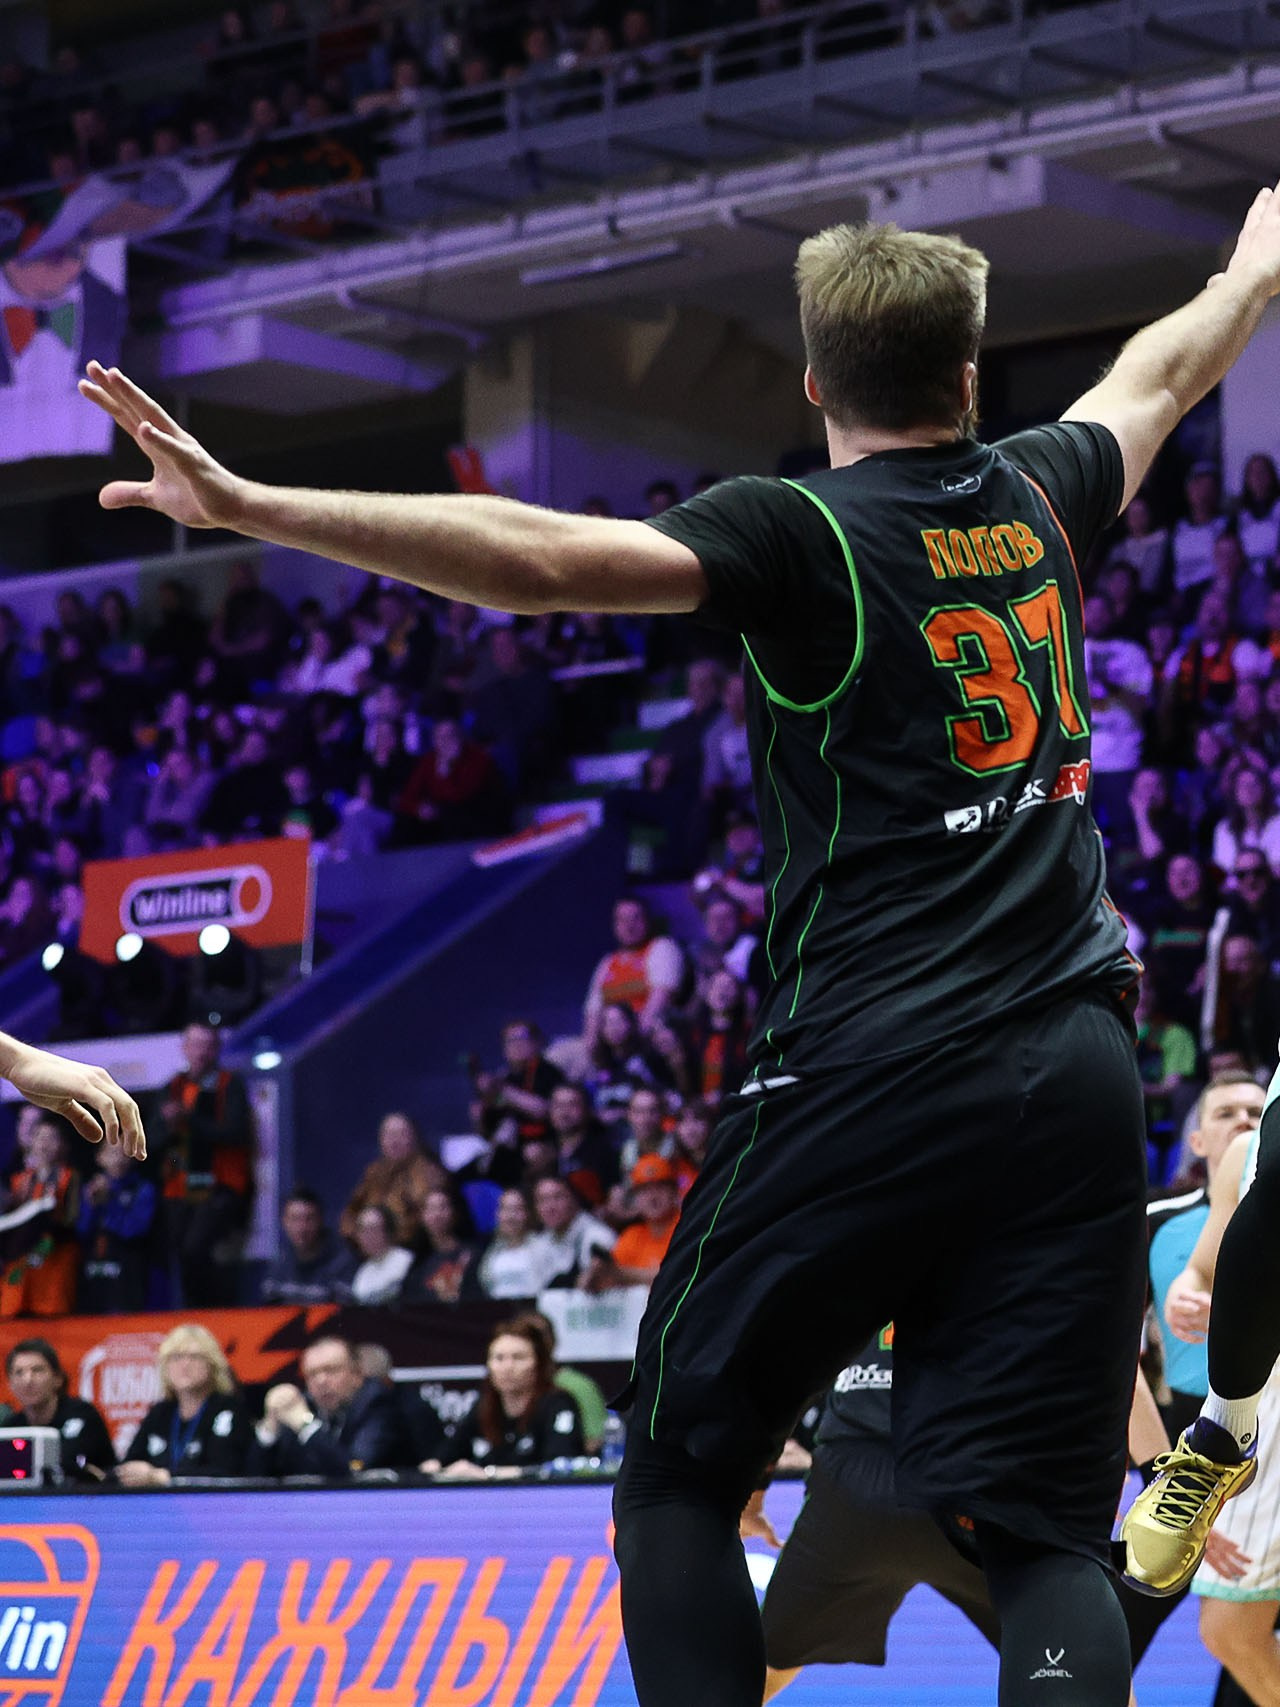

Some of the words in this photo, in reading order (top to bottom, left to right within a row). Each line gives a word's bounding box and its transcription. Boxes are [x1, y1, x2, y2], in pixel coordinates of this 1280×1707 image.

[921, 520, 1044, 579] ПОПОВ
[919, 579, 1090, 778] 37
[99, 1545, 622, 1707] КАЖДЫЙ
